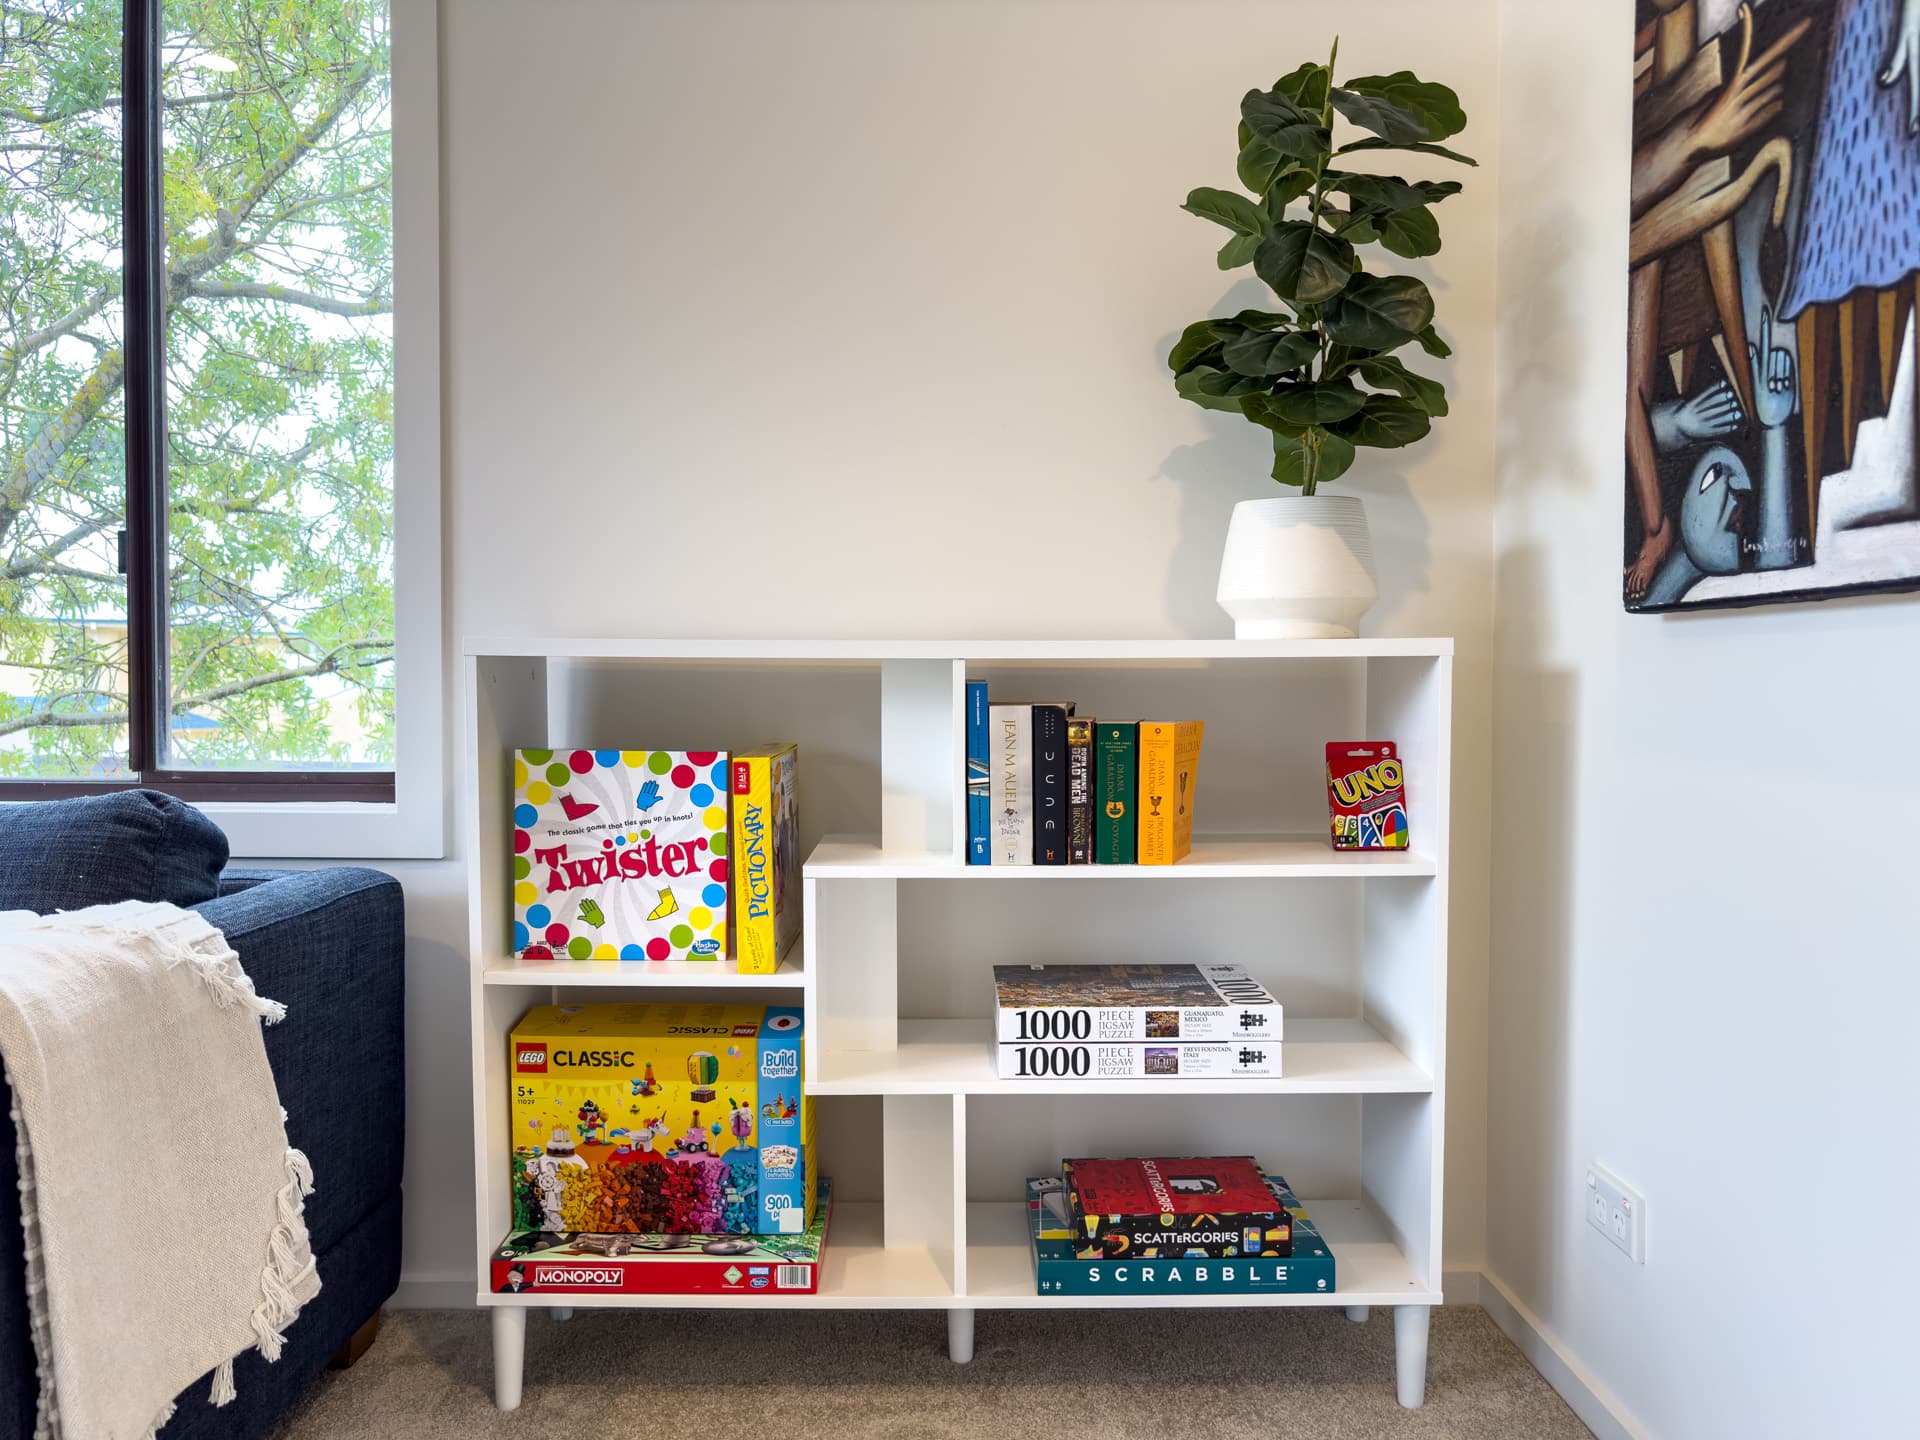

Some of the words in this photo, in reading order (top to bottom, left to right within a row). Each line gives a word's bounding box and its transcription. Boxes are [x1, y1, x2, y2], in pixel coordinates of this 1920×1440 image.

[1002, 720, 1016, 750] JEAN
[1005, 754, 1016, 766] M
[1072, 748, 1081, 776] DEAD
[1004, 771, 1016, 808] AUEL
[1332, 759, 1403, 807] UNO
[1072, 779, 1081, 804] MEN
[562, 828, 584, 836] classic
[586, 824, 606, 832] game
[624, 818, 638, 826] ties
[638, 818, 652, 826] you
[672, 812, 694, 821] knots!
[1072, 808, 1080, 847] BROWNE
[1350, 820, 1357, 828] 3
[1362, 818, 1370, 827] 4
[534, 836, 708, 894] Twister
[746, 803, 770, 920] PICTIONARY
[1212, 978, 1274, 1005] 1000
[1099, 1011, 1134, 1020] PIECE
[1016, 1010, 1091, 1040] 1000
[1099, 1030, 1134, 1039] PUZZLE
[518, 1051, 545, 1064] LEGO
[766, 1053, 794, 1066] Build
[1098, 1048, 1133, 1057] PIECE
[1015, 1046, 1090, 1076] 1000
[763, 1067, 796, 1076] together
[1098, 1067, 1133, 1075] PUZZLE
[518, 1086, 535, 1097] 5+
[1142, 1160, 1174, 1212] SCATTERGORIES
[768, 1196, 790, 1210] 900
[1134, 1232, 1239, 1244] SCATTERGORIES
[540, 1271, 620, 1283] MONOPOLY
[1089, 1266, 1288, 1282] SCRABBLE
